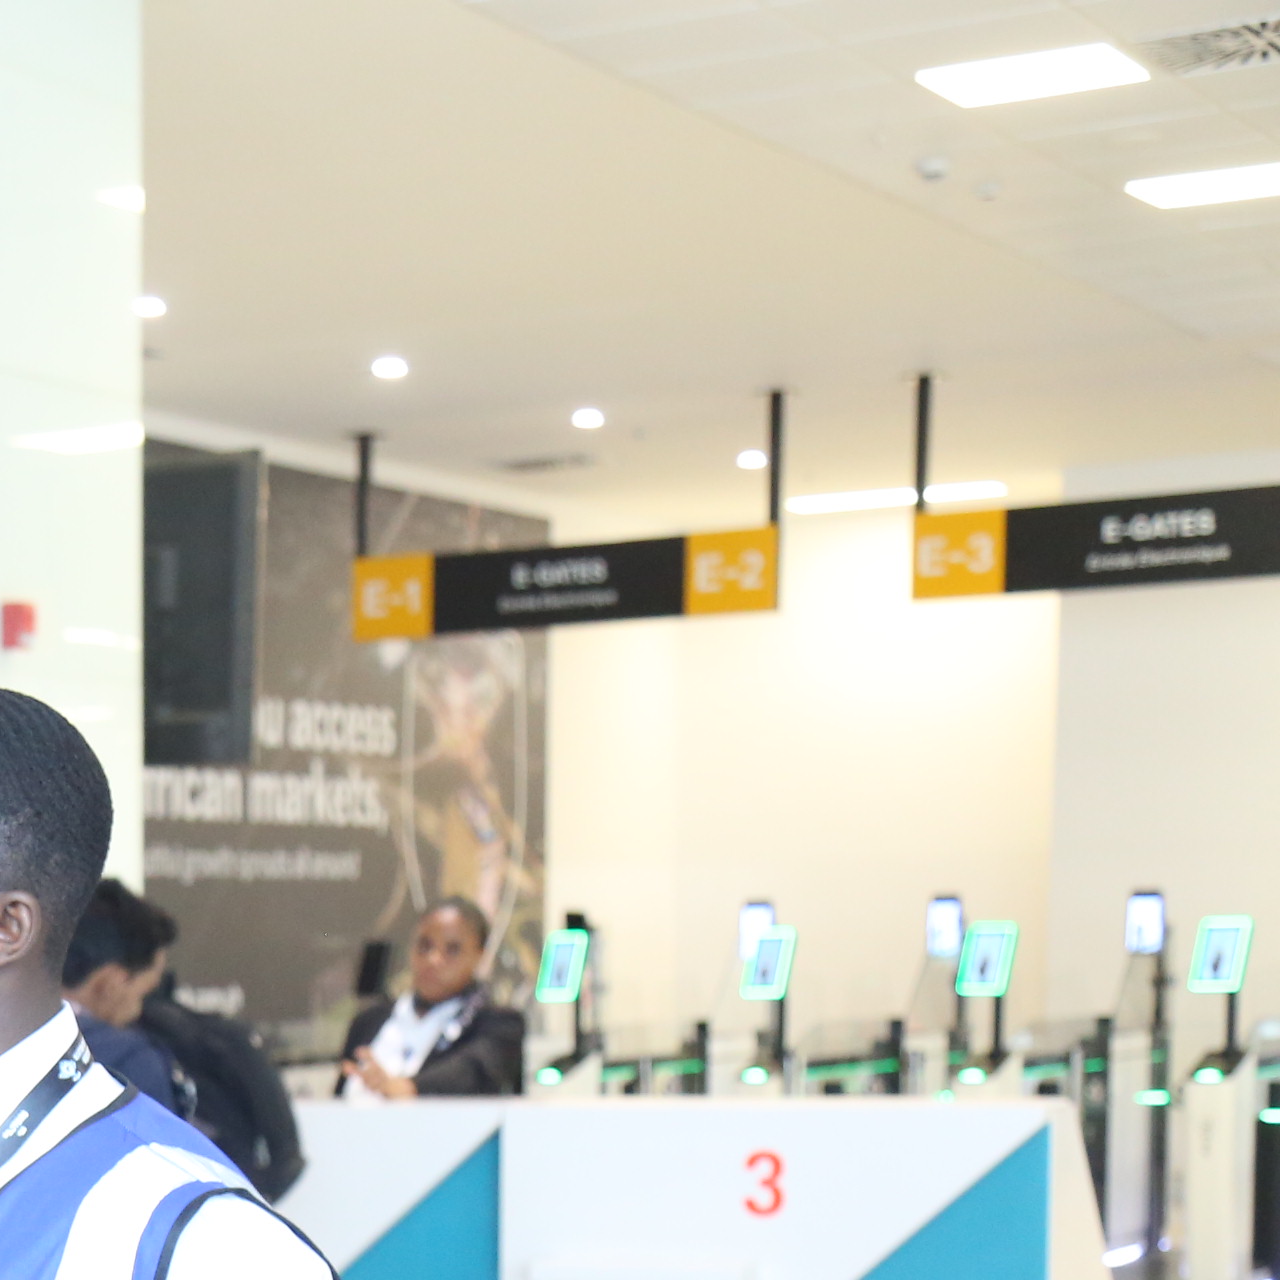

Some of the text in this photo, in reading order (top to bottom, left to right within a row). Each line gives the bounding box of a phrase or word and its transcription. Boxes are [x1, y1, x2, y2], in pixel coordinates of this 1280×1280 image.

[1100, 508, 1216, 544] E-GATES
[510, 557, 608, 591] E-GATES
[693, 549, 766, 594] E-2
[917, 532, 995, 578] E-3
[361, 577, 423, 618] E-1
[289, 698, 397, 758] access
[744, 1150, 786, 1217] 3
